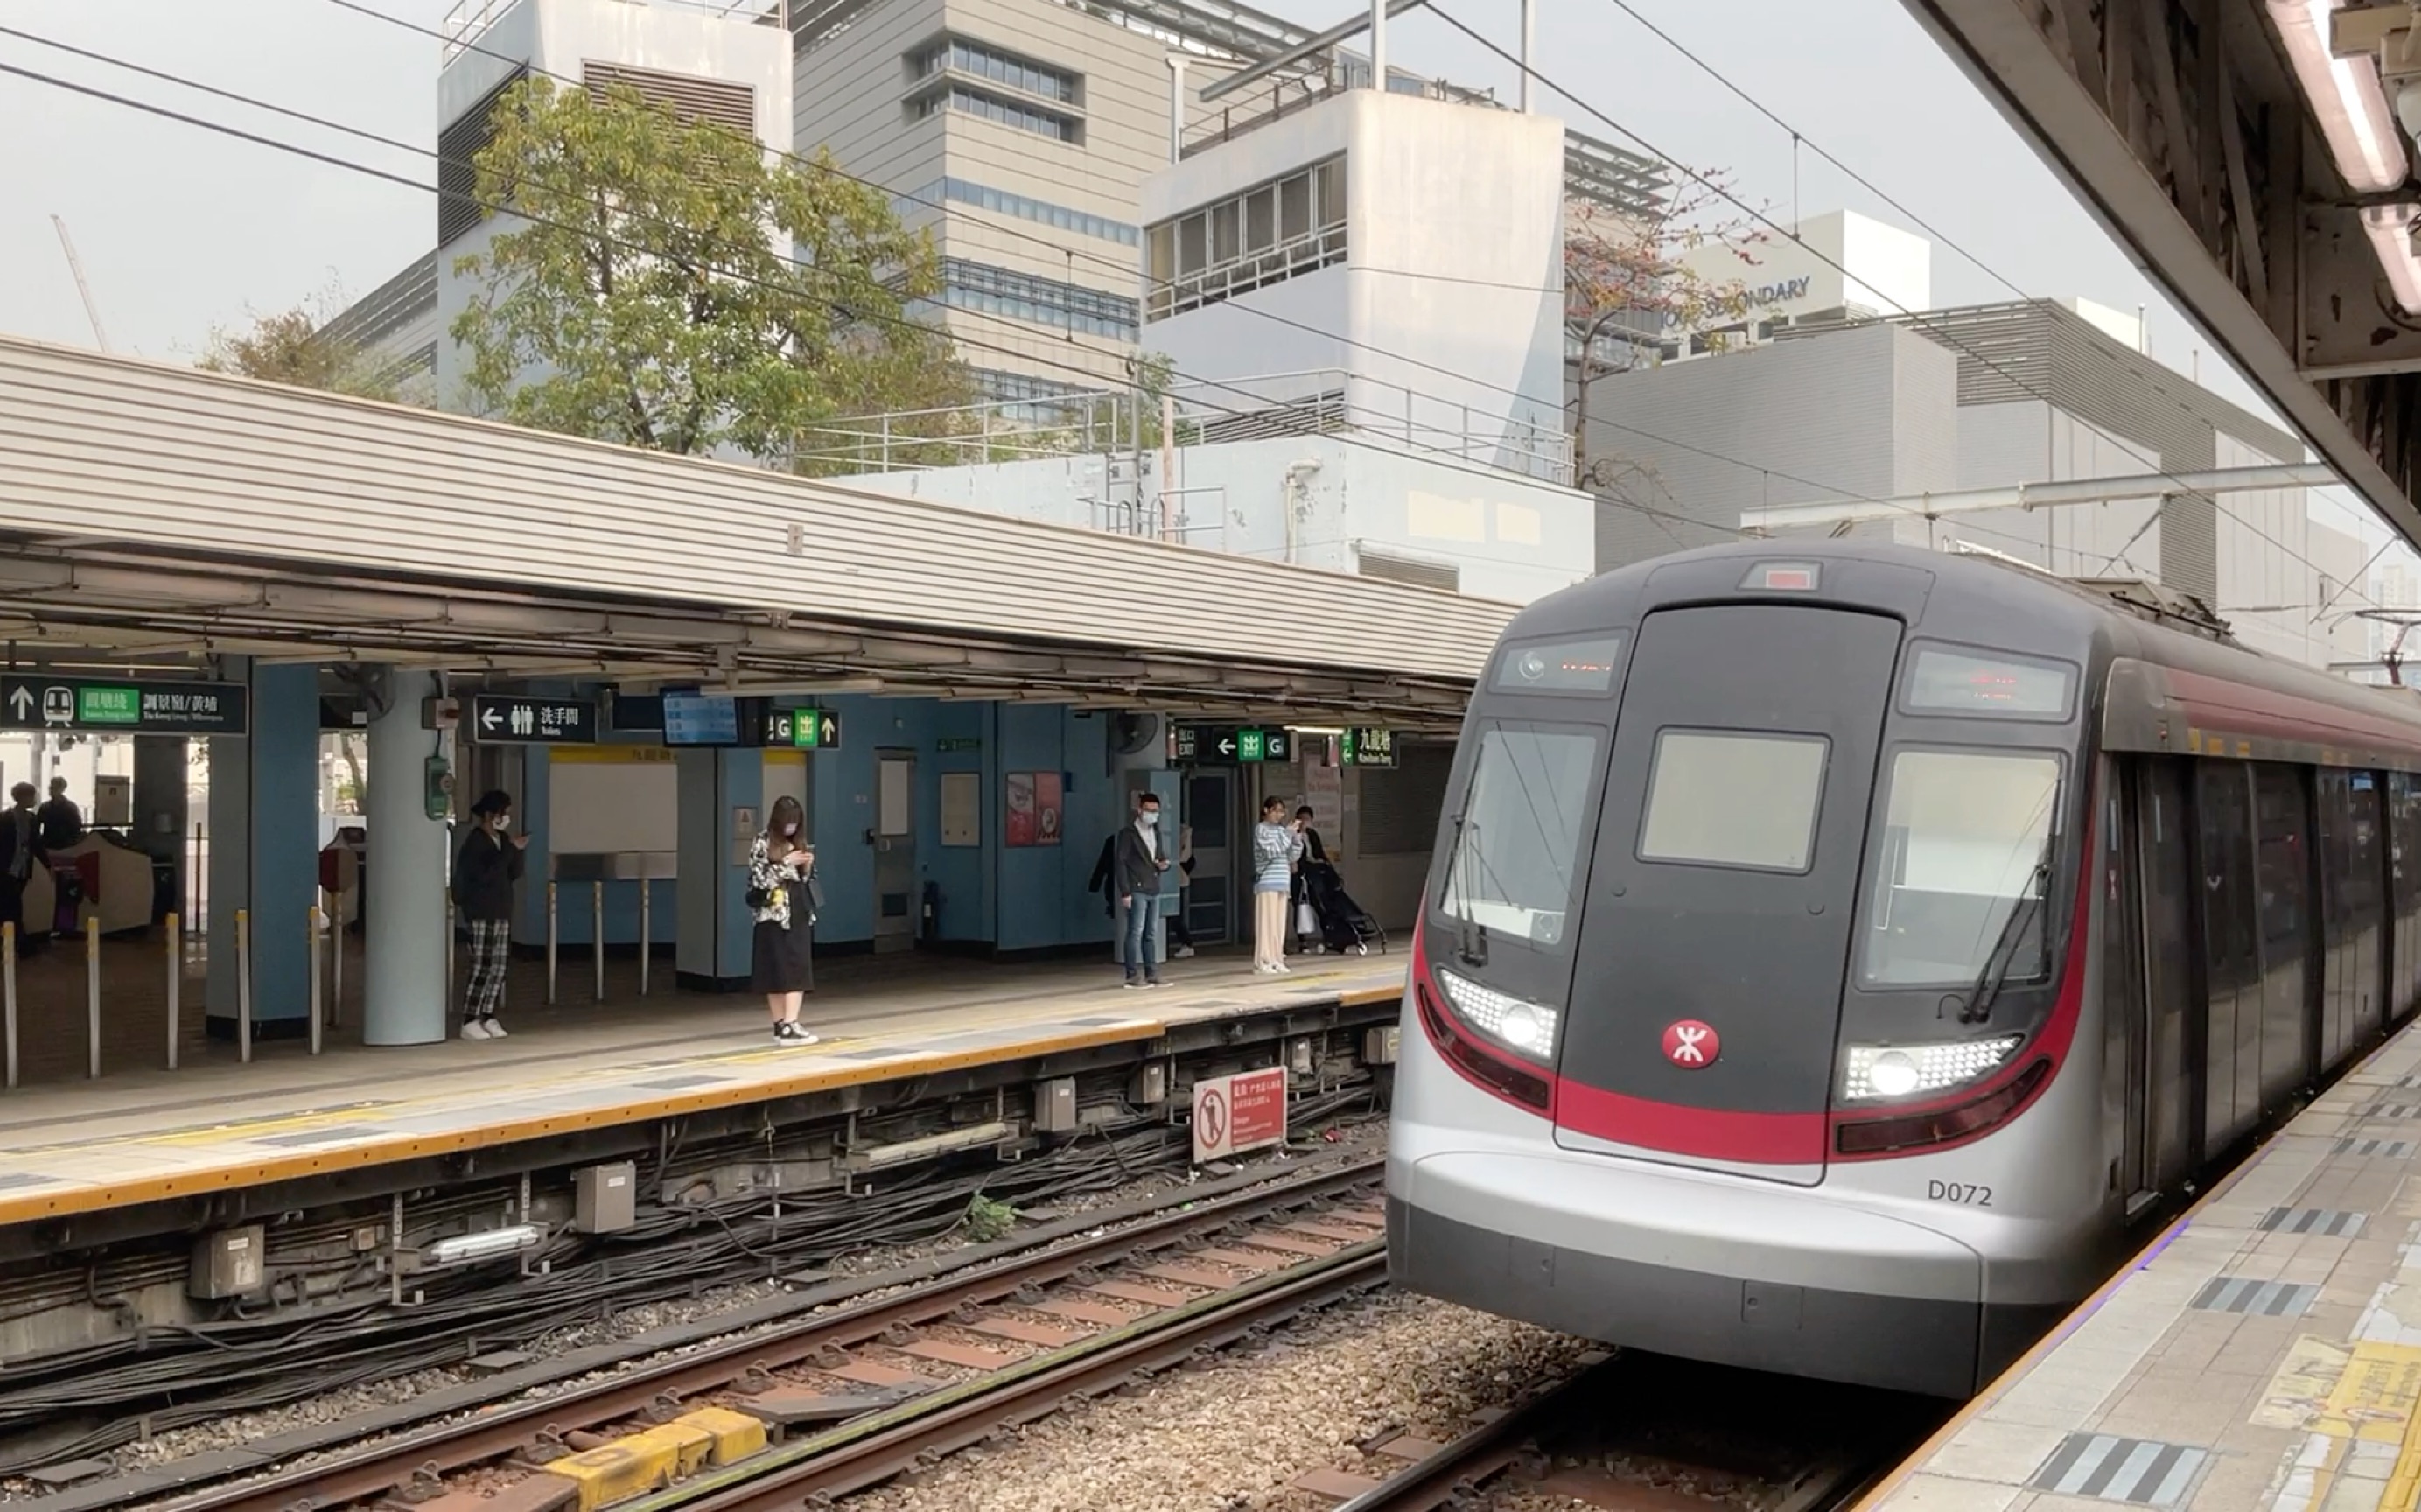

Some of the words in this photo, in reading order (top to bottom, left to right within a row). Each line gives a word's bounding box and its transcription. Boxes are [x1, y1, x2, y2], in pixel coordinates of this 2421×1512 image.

[541, 706, 578, 725] 洗手間
[800, 715, 814, 733] 出
[778, 719, 791, 737] G
[1243, 735, 1259, 749] 出
[1928, 1180, 1992, 1207] D072
